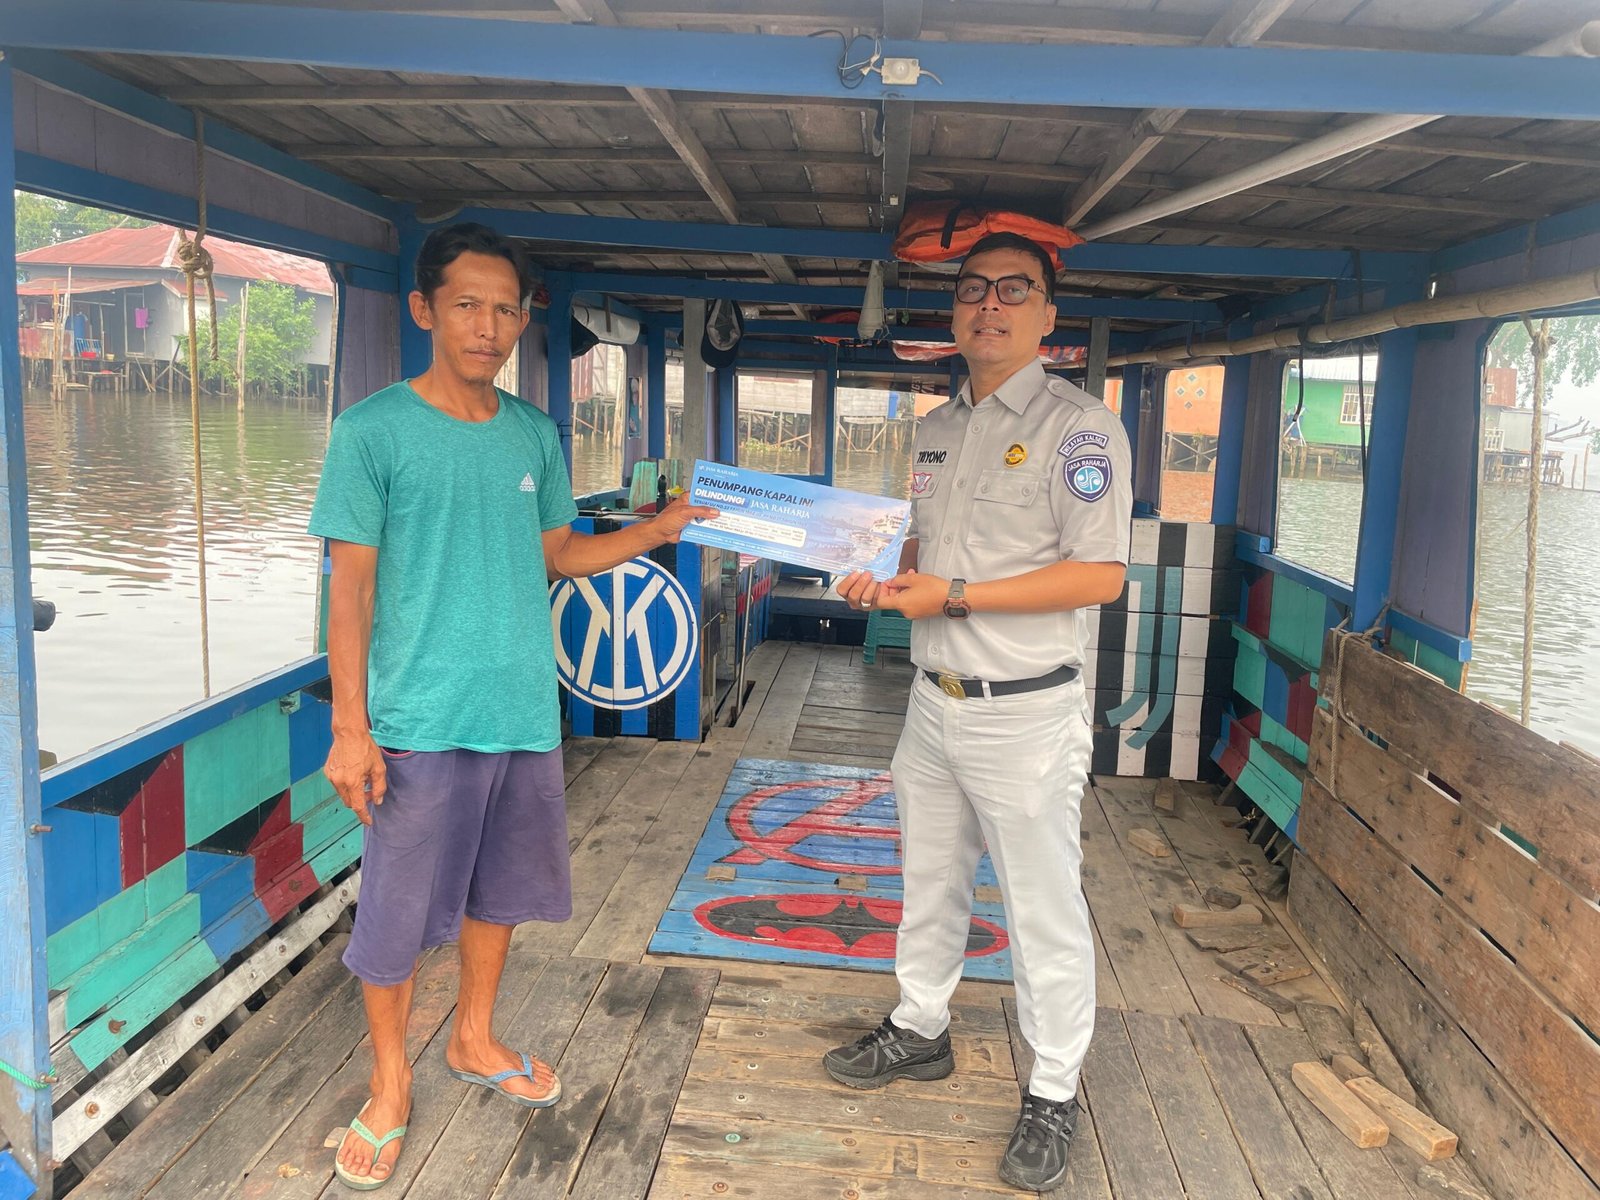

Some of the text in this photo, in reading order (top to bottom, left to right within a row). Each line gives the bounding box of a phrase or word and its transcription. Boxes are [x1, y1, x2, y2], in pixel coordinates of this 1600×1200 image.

[1064, 435, 1084, 453] WILAYAH
[917, 450, 947, 464] TRIYONO
[1068, 459, 1106, 472] JASA RAHARJA
[697, 476, 814, 507] PENUMPANG KAPAL INI
[695, 489, 746, 505] DILINDUNGI
[751, 500, 770, 511] JASA
[771, 504, 810, 519] RAHARJA
